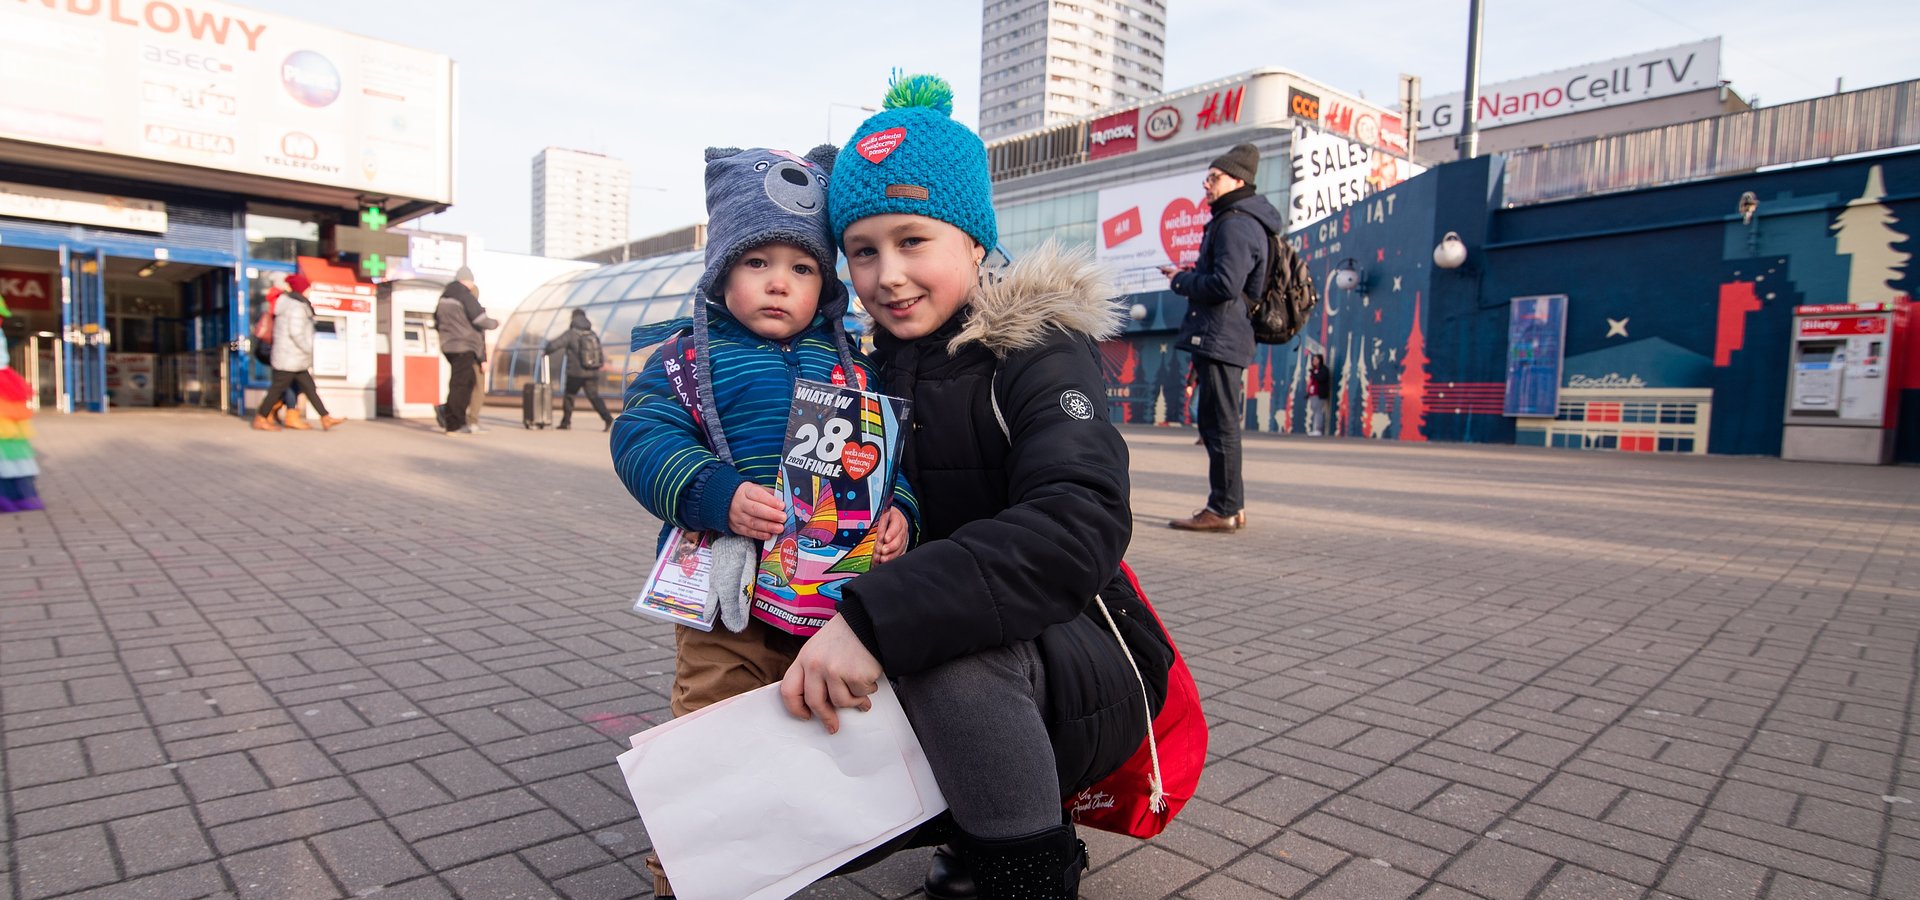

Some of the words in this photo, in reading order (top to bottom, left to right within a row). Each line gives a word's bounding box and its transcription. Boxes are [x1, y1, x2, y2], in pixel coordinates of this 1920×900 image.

[1418, 105, 1452, 130] LG
[1638, 52, 1696, 88] TV
[147, 126, 234, 154] APTEKA
[265, 156, 340, 173] TELEFONY
[666, 358, 681, 374] 28
[1568, 373, 1647, 388] Zodiak
[795, 387, 835, 406] WIATR
[834, 395, 854, 410] W
[786, 417, 853, 462] 28
[788, 455, 804, 466] 2020
[804, 458, 843, 478] FINAŁ
[755, 599, 768, 611] DLA
[768, 604, 808, 625] DZIECIĘCEJ
